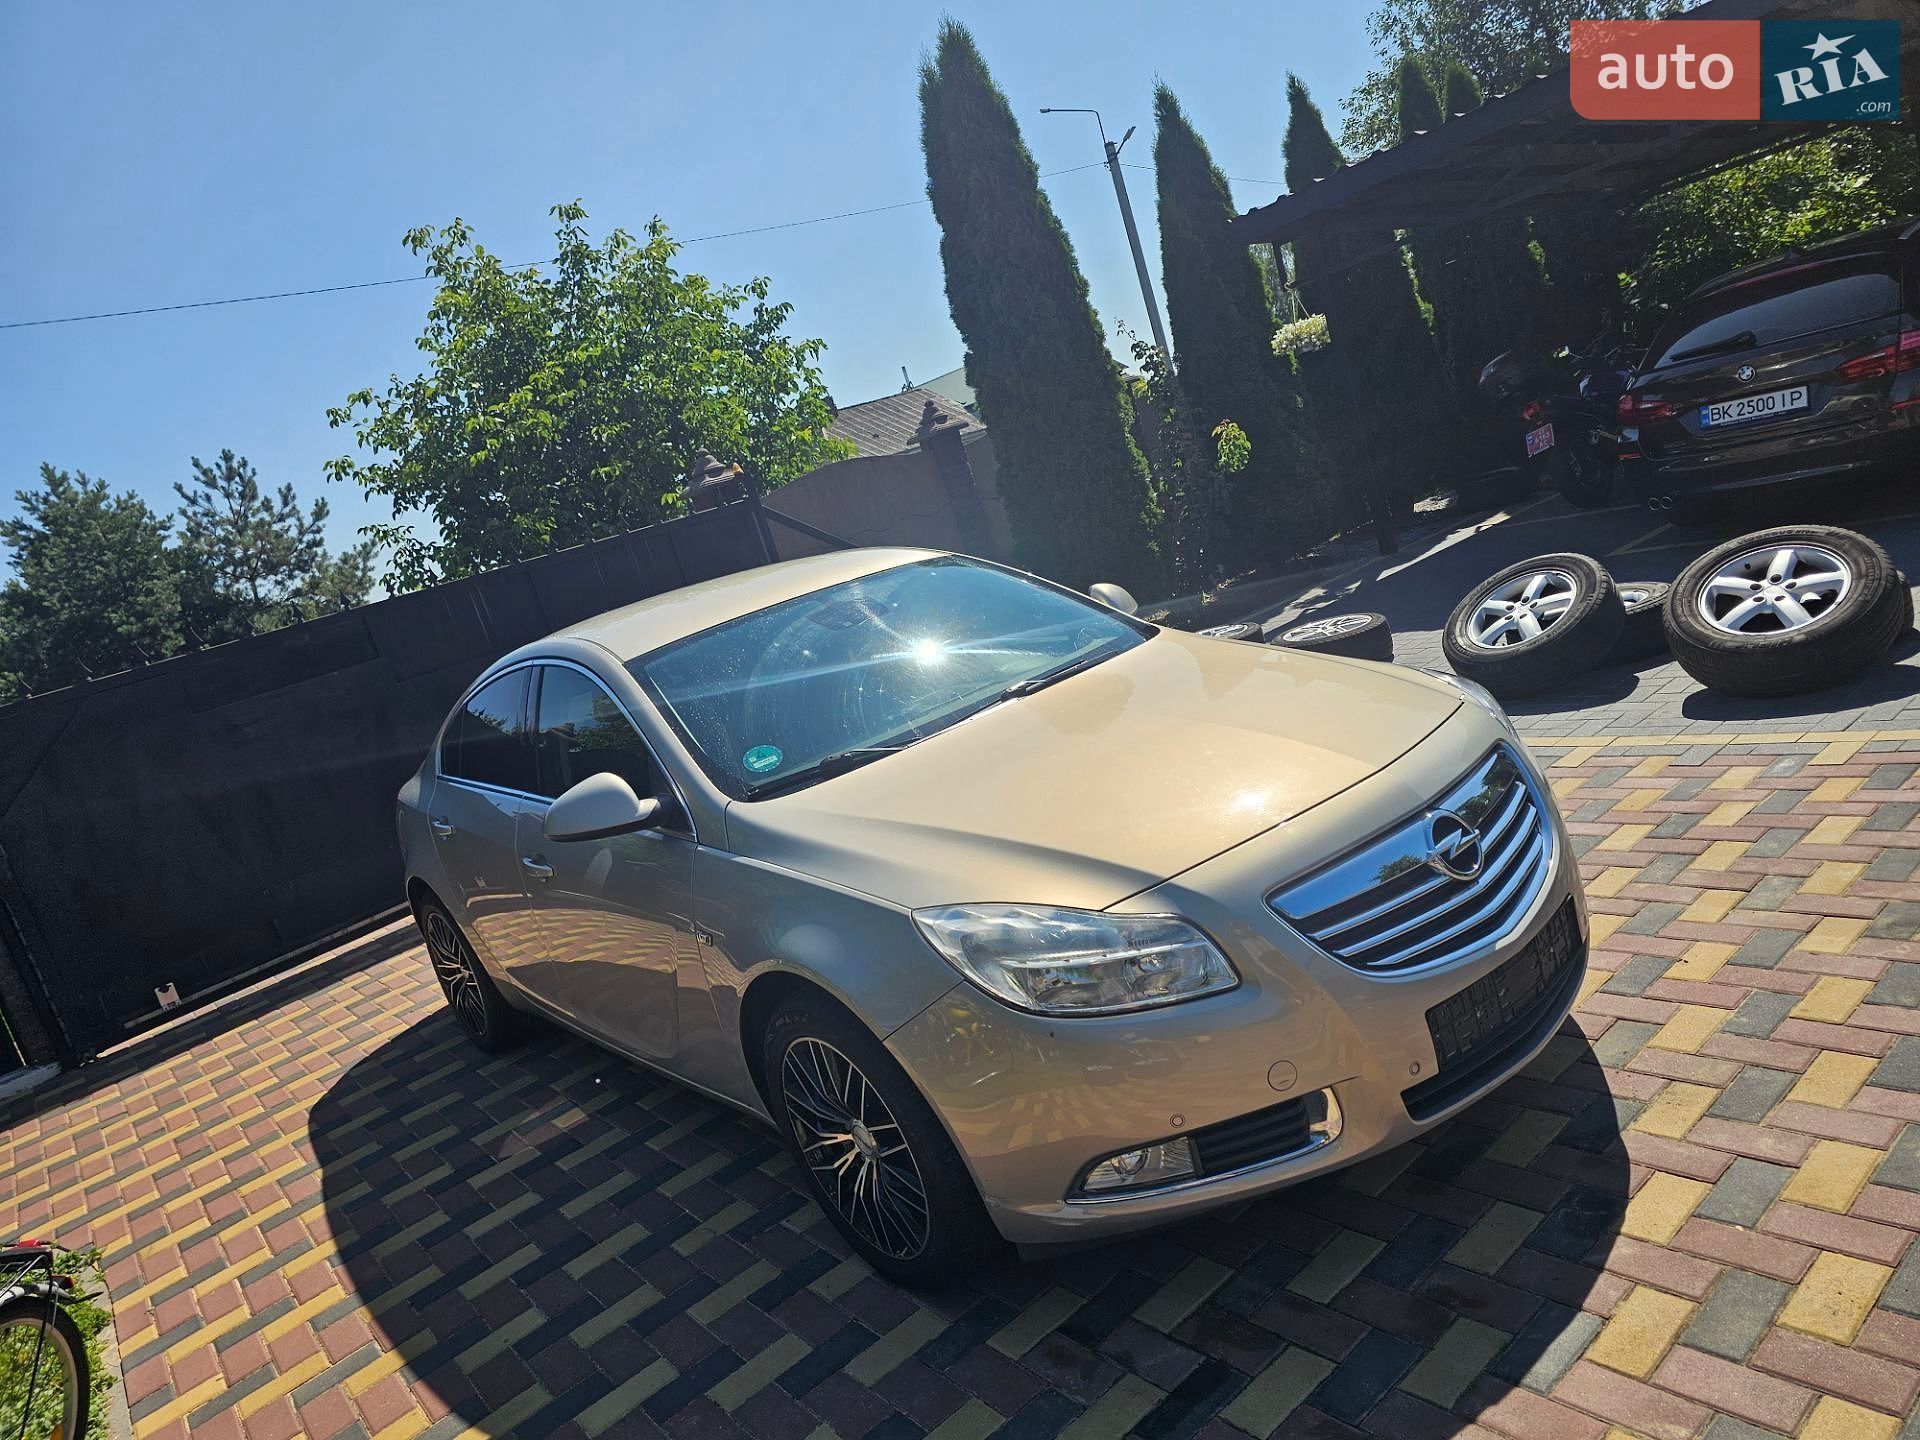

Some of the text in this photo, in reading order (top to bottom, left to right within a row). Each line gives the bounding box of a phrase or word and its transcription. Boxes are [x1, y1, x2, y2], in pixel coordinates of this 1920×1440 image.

[1710, 404, 1733, 422] BK
[1736, 396, 1776, 417] 2500
[1781, 390, 1803, 408] IP
